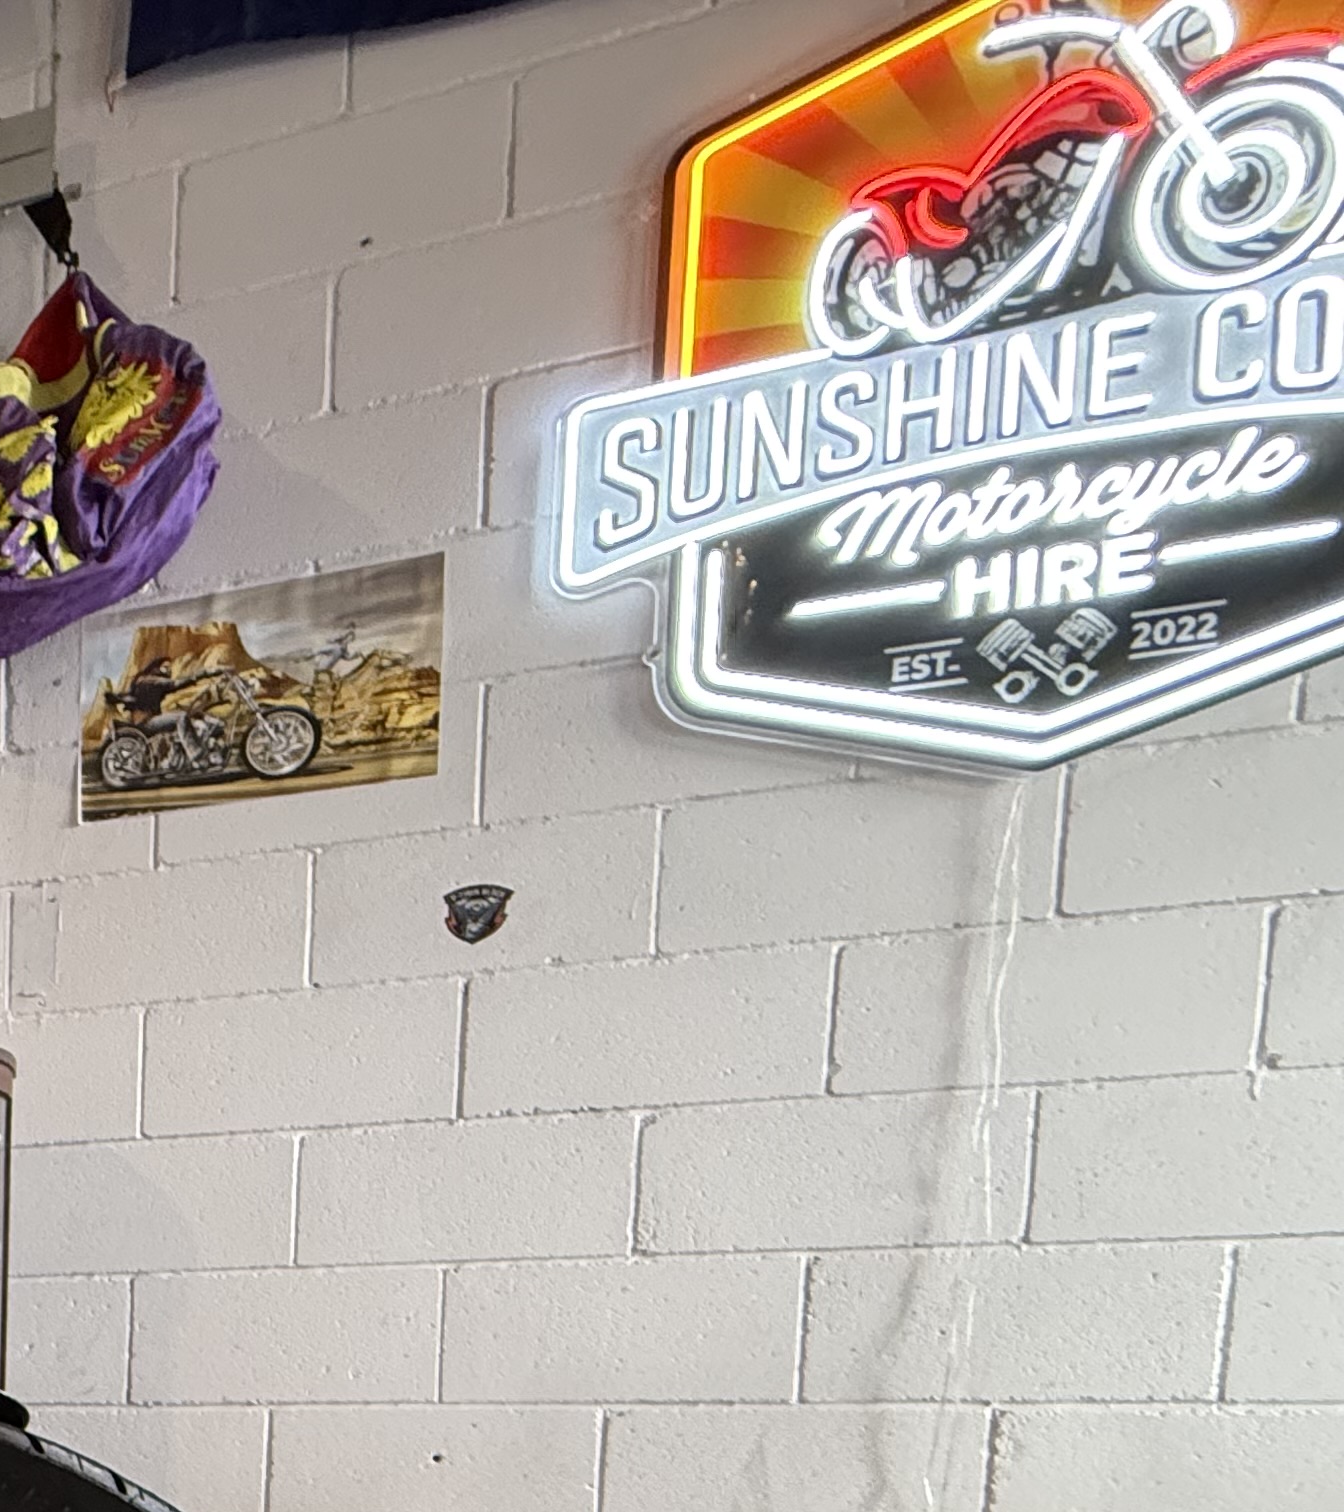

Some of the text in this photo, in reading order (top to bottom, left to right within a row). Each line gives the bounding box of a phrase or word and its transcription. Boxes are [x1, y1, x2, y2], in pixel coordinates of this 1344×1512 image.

[596, 312, 1154, 552] SUNSHINE
[815, 426, 1310, 568] Motorcycle
[949, 530, 1162, 620] HIRE
[1130, 612, 1218, 650] 2022
